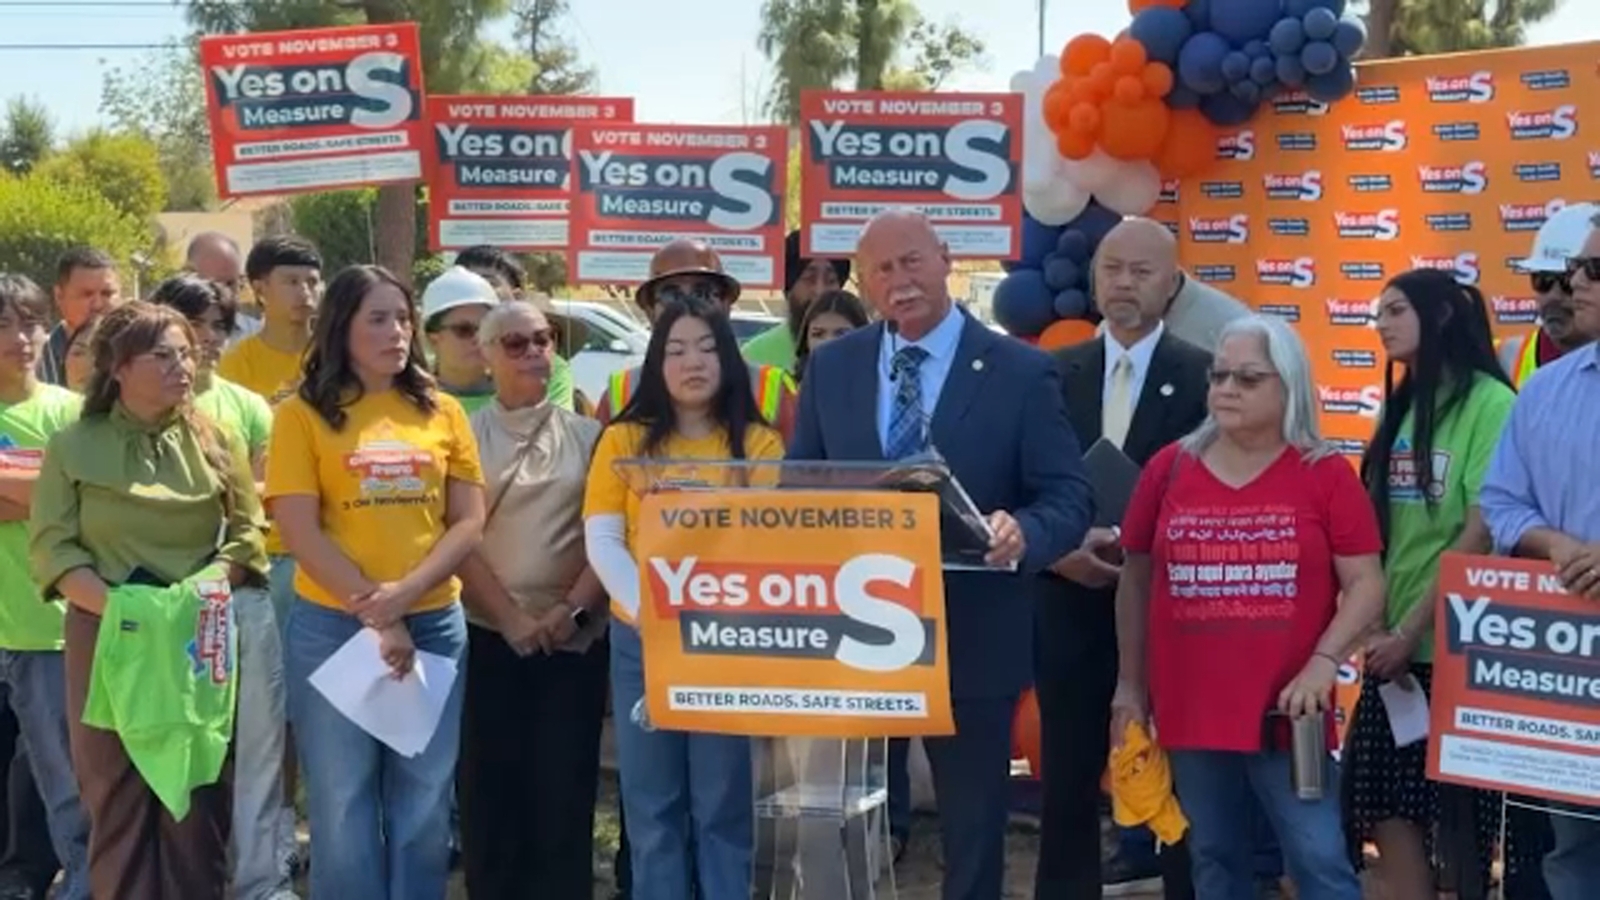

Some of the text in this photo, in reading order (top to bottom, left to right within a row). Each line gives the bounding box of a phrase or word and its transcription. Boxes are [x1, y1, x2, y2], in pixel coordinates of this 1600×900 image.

[222, 33, 399, 58] VOTE NOVEMBER 3
[211, 51, 413, 129] Yes on S
[1426, 77, 1448, 90] Yes
[1468, 71, 1493, 103] S
[243, 103, 345, 126] Measure
[449, 104, 616, 118] VOTE NOVEMBER 3
[823, 100, 1004, 116] VOTE NOVEMBER 3
[1506, 111, 1531, 126] Yes
[1550, 105, 1576, 139] S
[435, 122, 557, 156] Yes on
[592, 130, 767, 148] VOTE NOVEMBER 3
[1235, 131, 1254, 160] S
[1341, 125, 1364, 139] Yes
[1382, 120, 1406, 152] S
[810, 119, 1011, 200] Yes on S
[460, 165, 557, 184] Measure
[835, 166, 939, 186] Measure
[1265, 175, 1283, 188] Yes
[1299, 171, 1322, 201] S
[1420, 165, 1442, 180] Yes
[1460, 161, 1486, 194] S
[579, 150, 648, 186] Yes
[655, 163, 705, 187] on
[707, 152, 773, 231] S
[602, 194, 703, 216] Measure
[1335, 211, 1357, 226] Yes
[1375, 208, 1398, 240] S
[1500, 203, 1522, 218] Yes
[1190, 217, 1211, 231] Yes
[1227, 214, 1248, 243] S
[1257, 260, 1276, 273] Yes
[1291, 257, 1314, 287] S
[1453, 252, 1478, 286] S
[1327, 299, 1348, 314] Yes
[1491, 297, 1516, 311] Yes
[1319, 385, 1341, 400] Yes
[1359, 385, 1381, 416] S
[661, 508, 917, 530] VOTE NOVEMBER 3
[1466, 568, 1530, 591] VOTE
[649, 553, 926, 673] Yes on S
[1447, 593, 1536, 650] Yes
[690, 621, 829, 649] Measure
[675, 692, 919, 711] BETTER ROADS. SAFE STREETS.
[1461, 711, 1600, 742] BETTER ROADS. SAF
